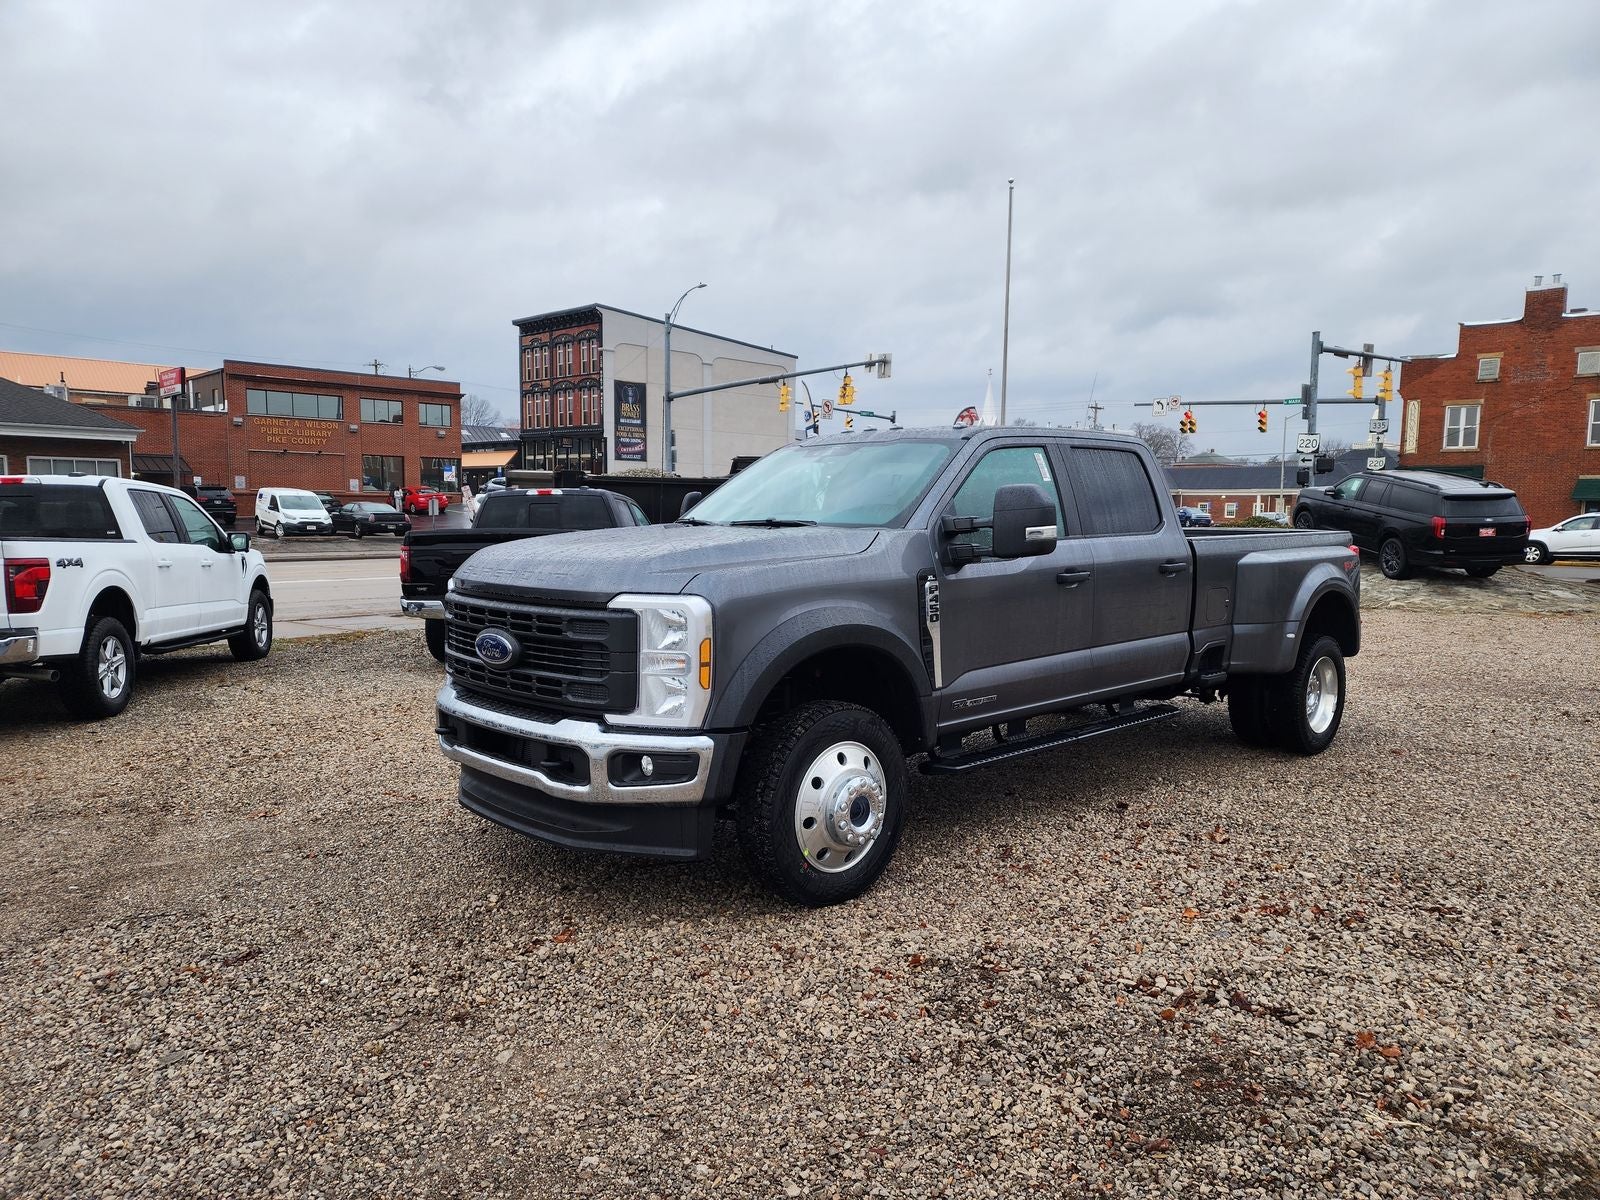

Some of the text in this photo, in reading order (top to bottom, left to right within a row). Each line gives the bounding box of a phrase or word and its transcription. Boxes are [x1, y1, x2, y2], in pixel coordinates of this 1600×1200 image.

[621, 402, 640, 412] BRASS
[254, 418, 290, 426] GARNET
[305, 421, 338, 429] WILSON
[1372, 422, 1386, 430] 335
[261, 427, 332, 437] PUBLIC LIBRARY
[267, 435, 327, 445] PIKE COUNTY
[1298, 438, 1318, 449] 220
[480, 638, 502, 659] Ford
